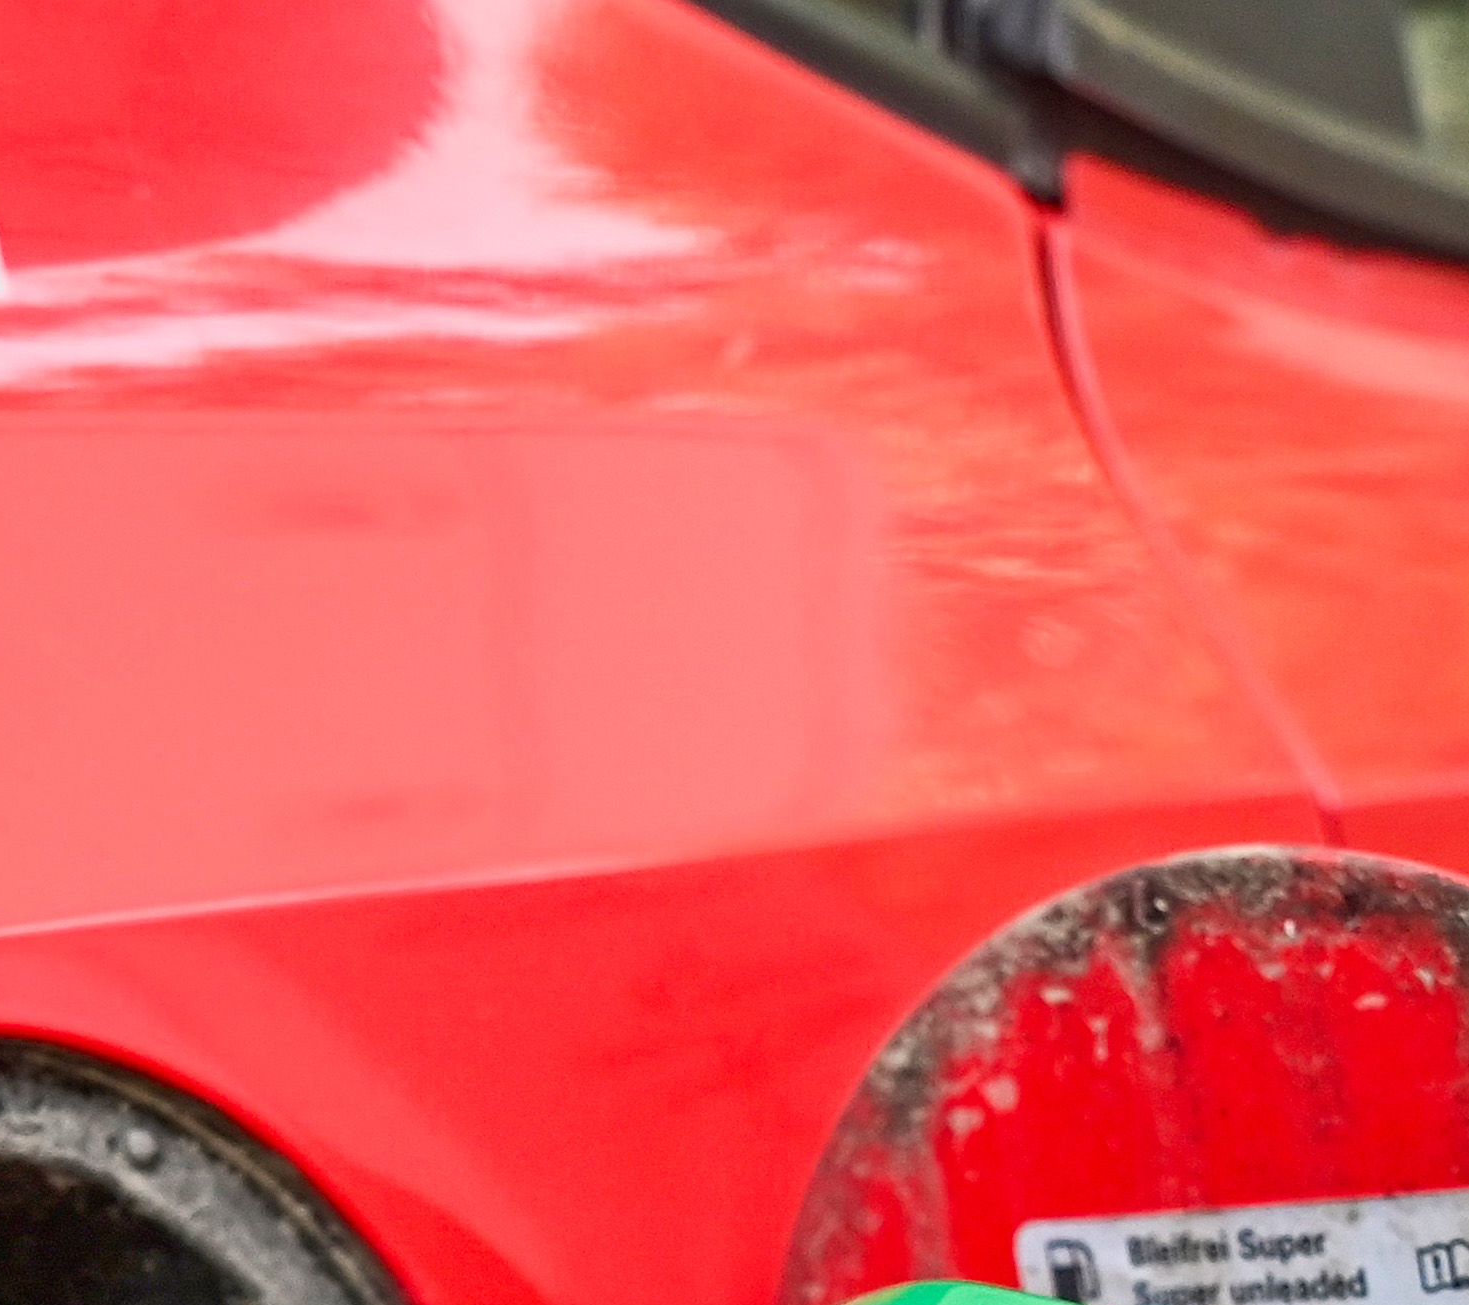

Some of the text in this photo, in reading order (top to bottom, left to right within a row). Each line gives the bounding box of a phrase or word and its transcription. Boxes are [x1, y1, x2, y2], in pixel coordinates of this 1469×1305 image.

[1127, 1228, 1325, 1267] Bleifrei Super
[1230, 1267, 1368, 1305] unleaded
